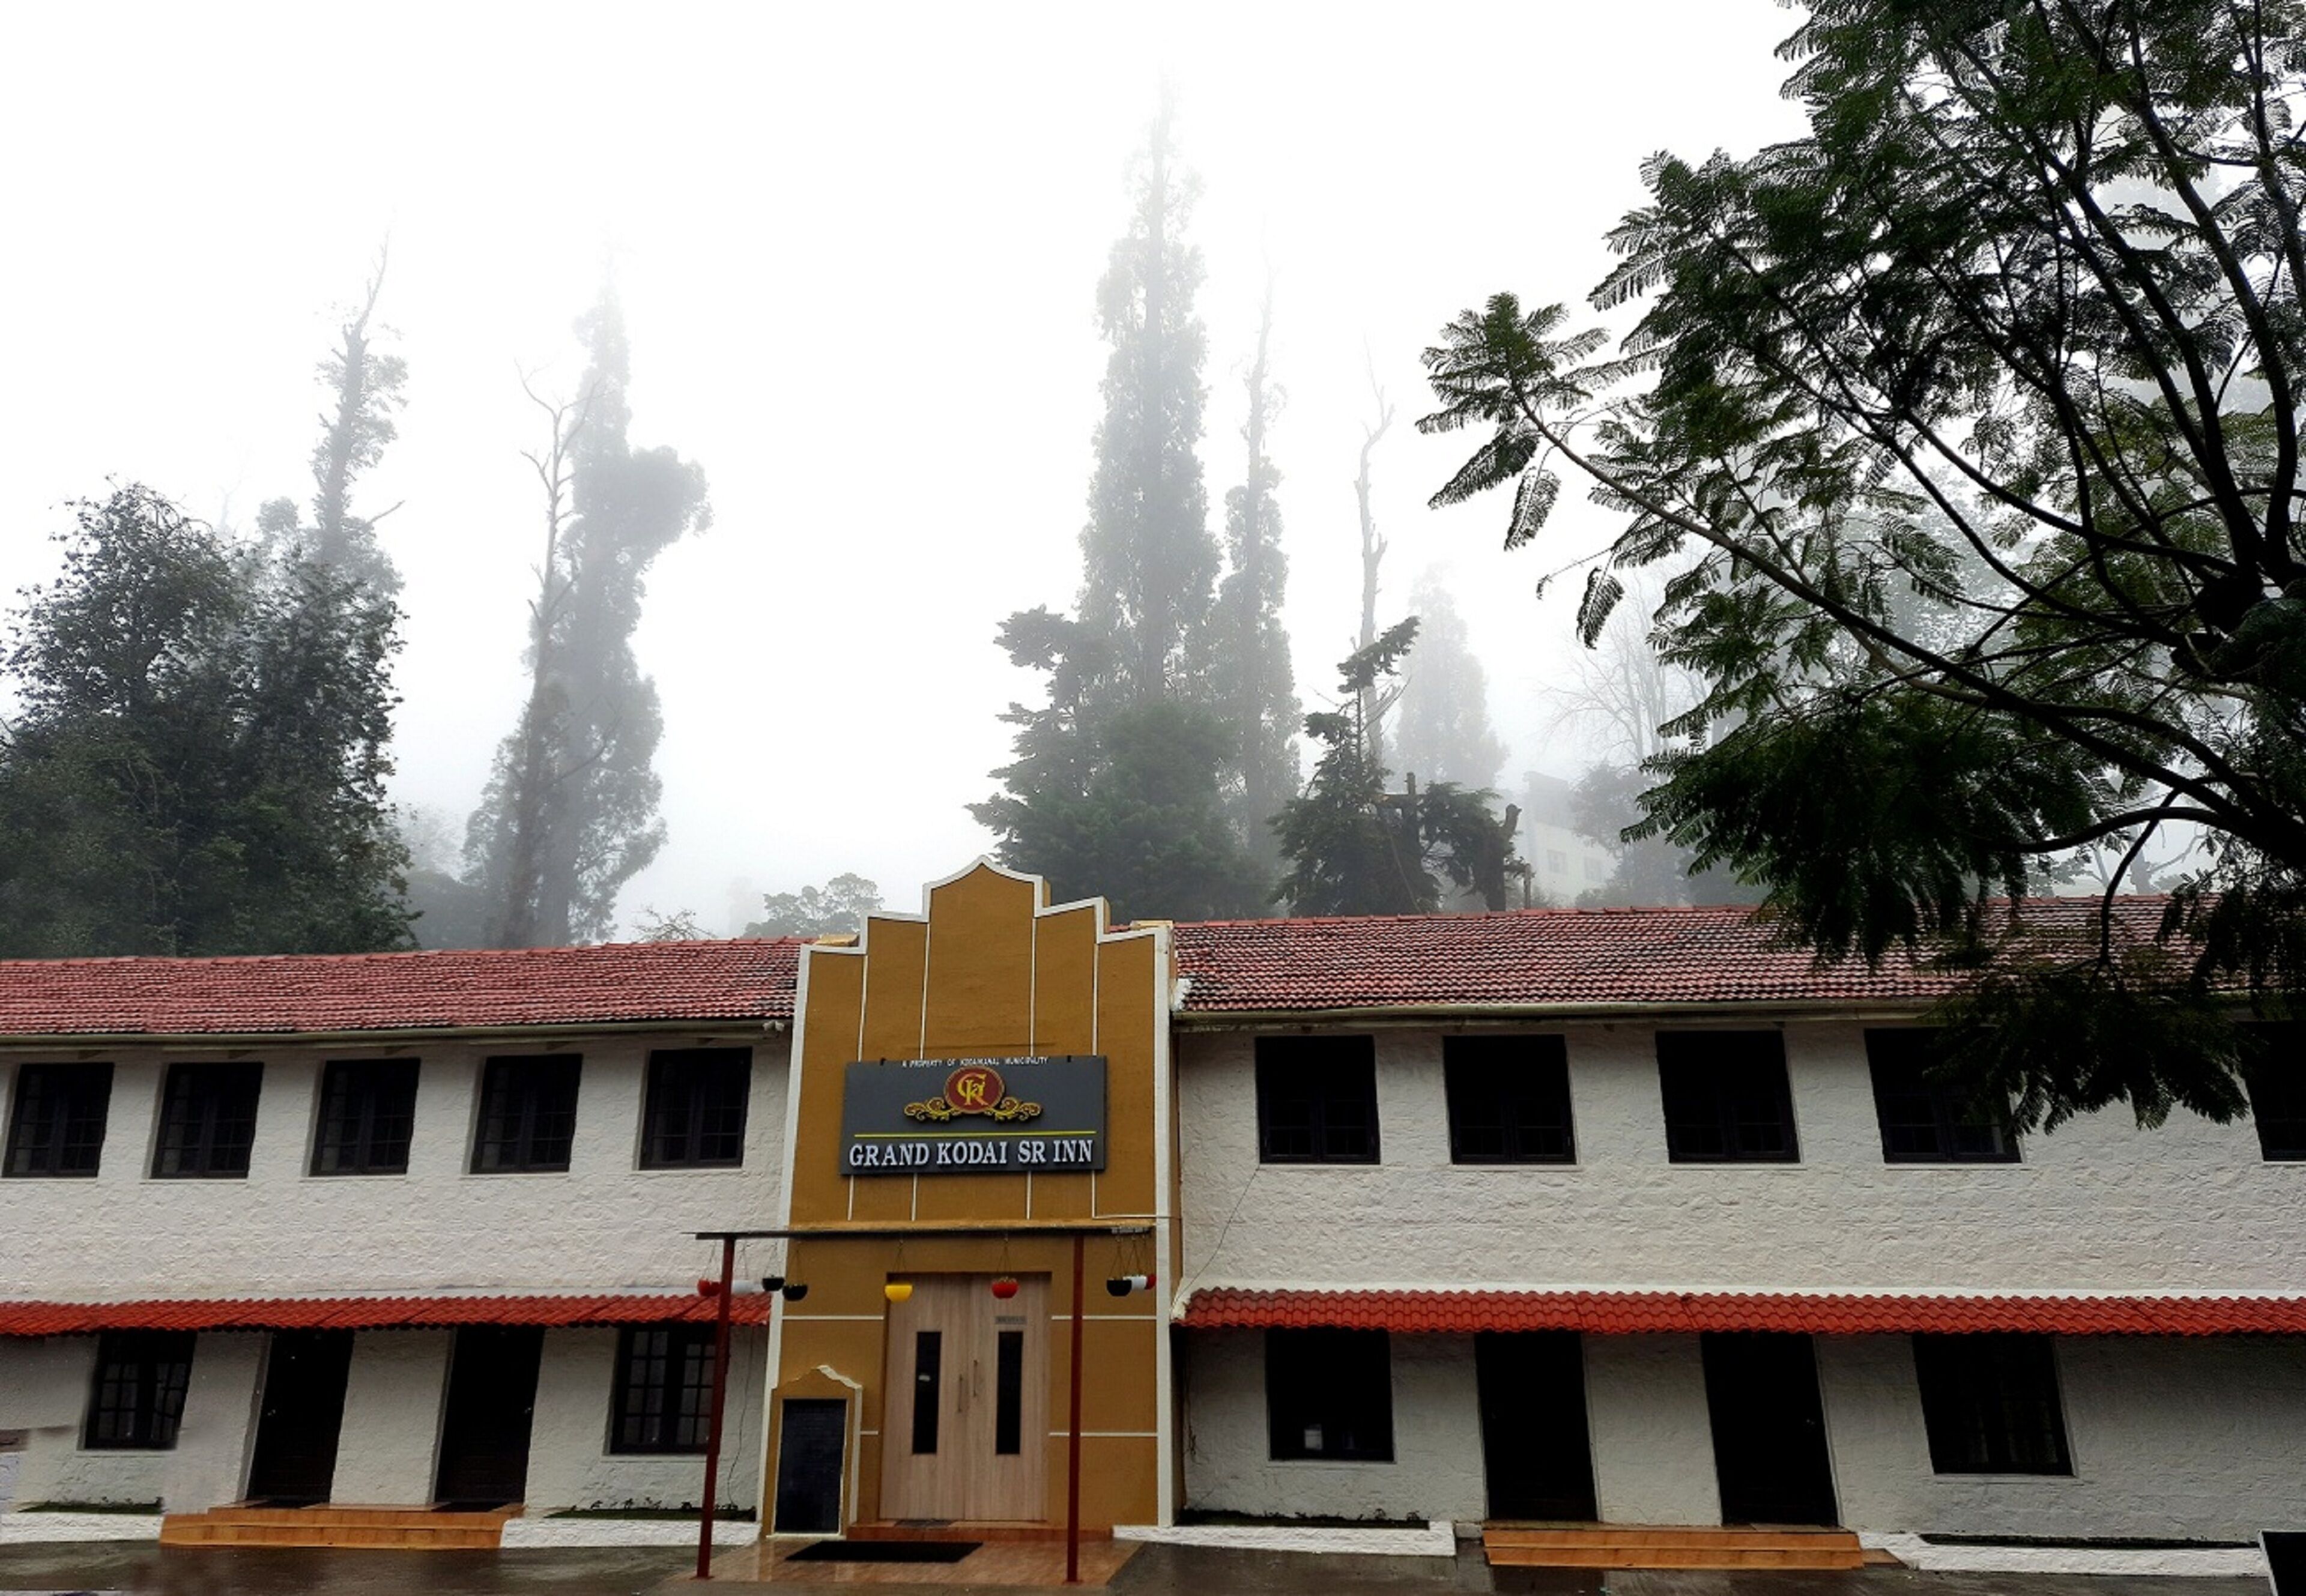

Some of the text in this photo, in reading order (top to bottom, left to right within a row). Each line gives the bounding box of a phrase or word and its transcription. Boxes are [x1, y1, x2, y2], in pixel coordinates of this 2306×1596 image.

[909, 1059, 943, 1068] PROPERTY
[947, 1058, 955, 1066] OF
[1005, 1056, 1049, 1065] MUNICIPALITY
[849, 1139, 1093, 1166] GRAND KODAI SR INN
